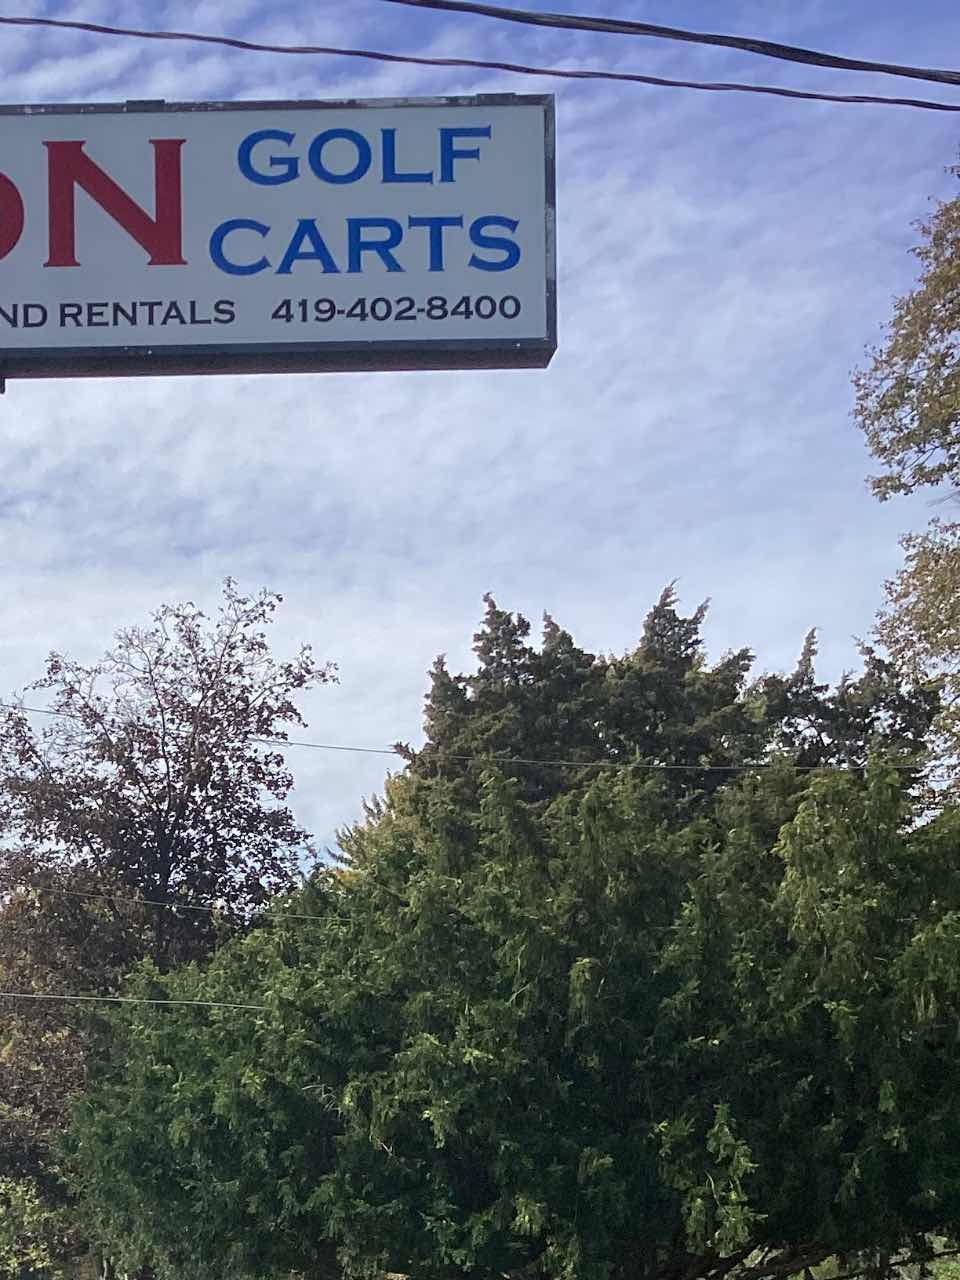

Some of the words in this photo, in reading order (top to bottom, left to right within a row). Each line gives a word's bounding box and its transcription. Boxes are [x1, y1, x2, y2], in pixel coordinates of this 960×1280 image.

[237, 125, 492, 186] GOLF
[209, 215, 522, 276] CARTS
[58, 299, 237, 327] RENTALS
[270, 295, 522, 324] 419-402-8400
